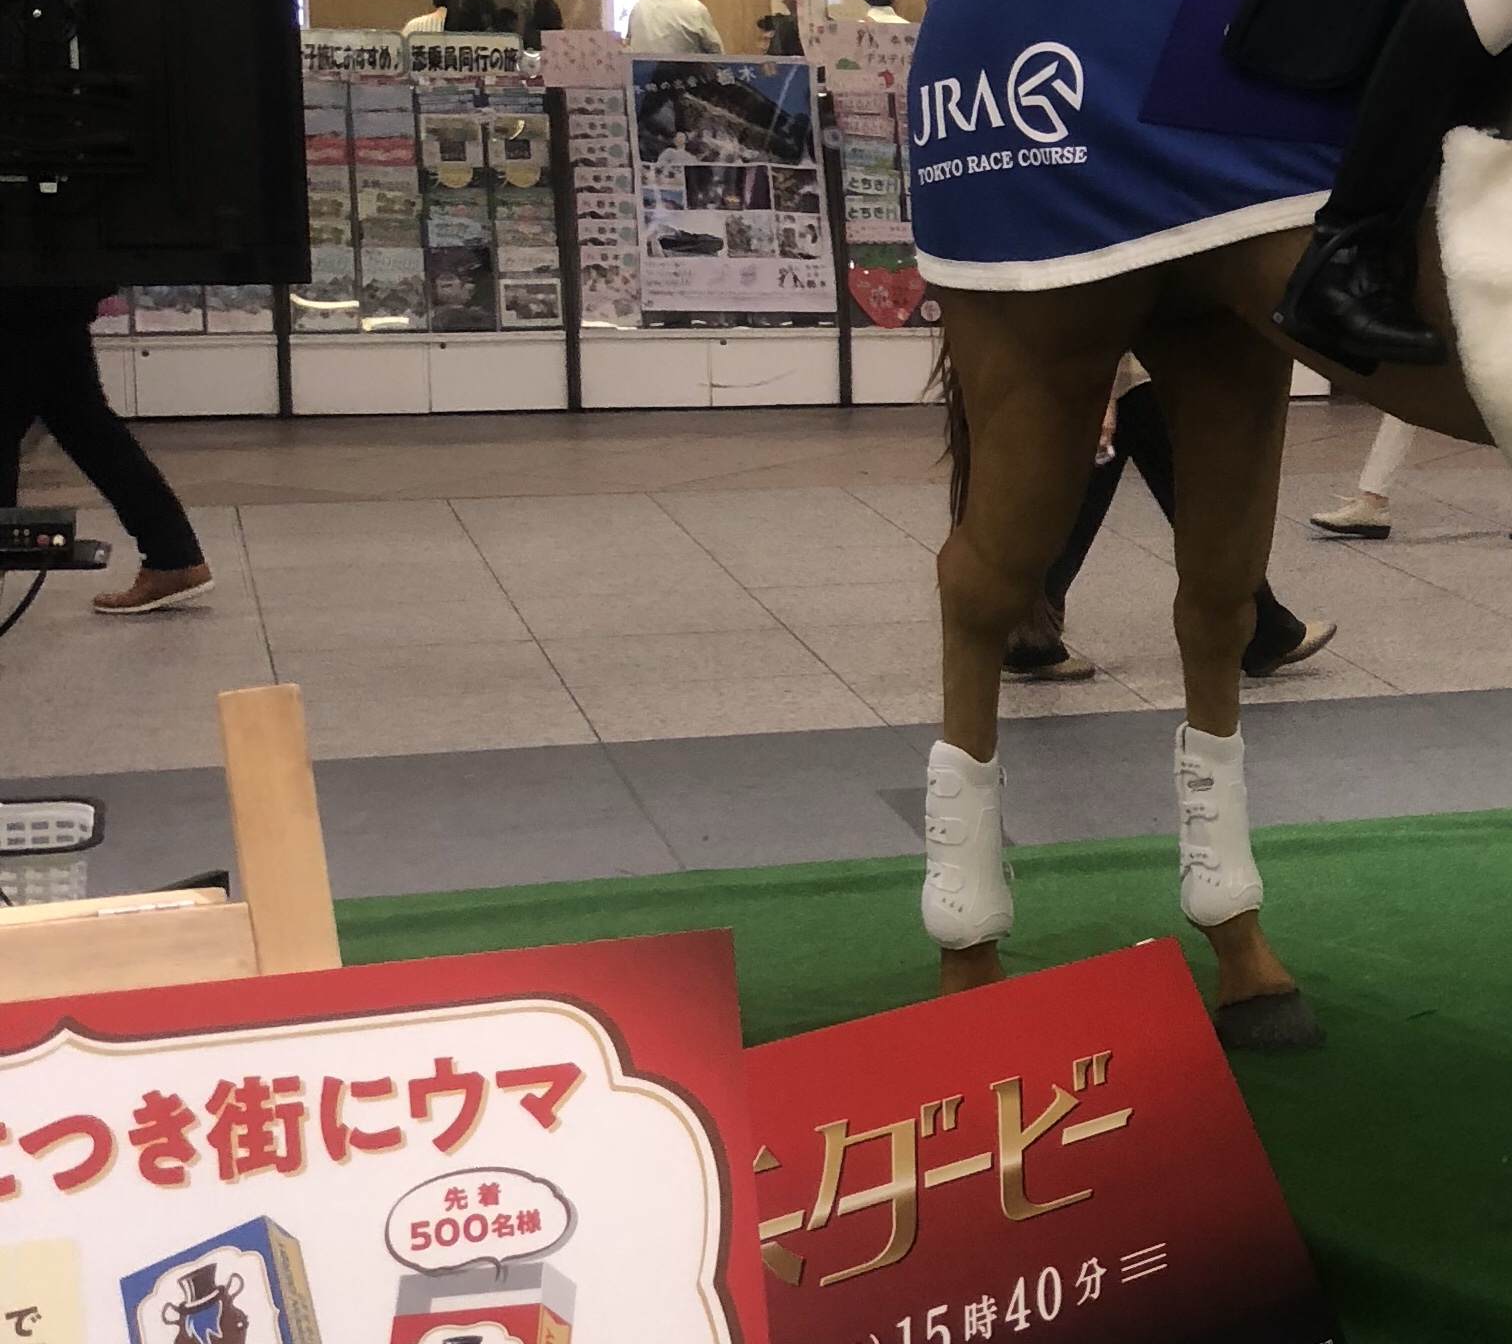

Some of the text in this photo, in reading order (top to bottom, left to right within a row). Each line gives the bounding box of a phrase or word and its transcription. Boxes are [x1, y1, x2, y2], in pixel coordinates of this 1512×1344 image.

[913, 68, 1006, 147] JRA
[917, 146, 1088, 186] TOKYO RACE COURSE
[0, 1057, 587, 1198] つき街にウマ
[443, 1183, 503, 1213] 先着
[410, 1208, 543, 1253] 500名様
[5, 1306, 43, 1337] で
